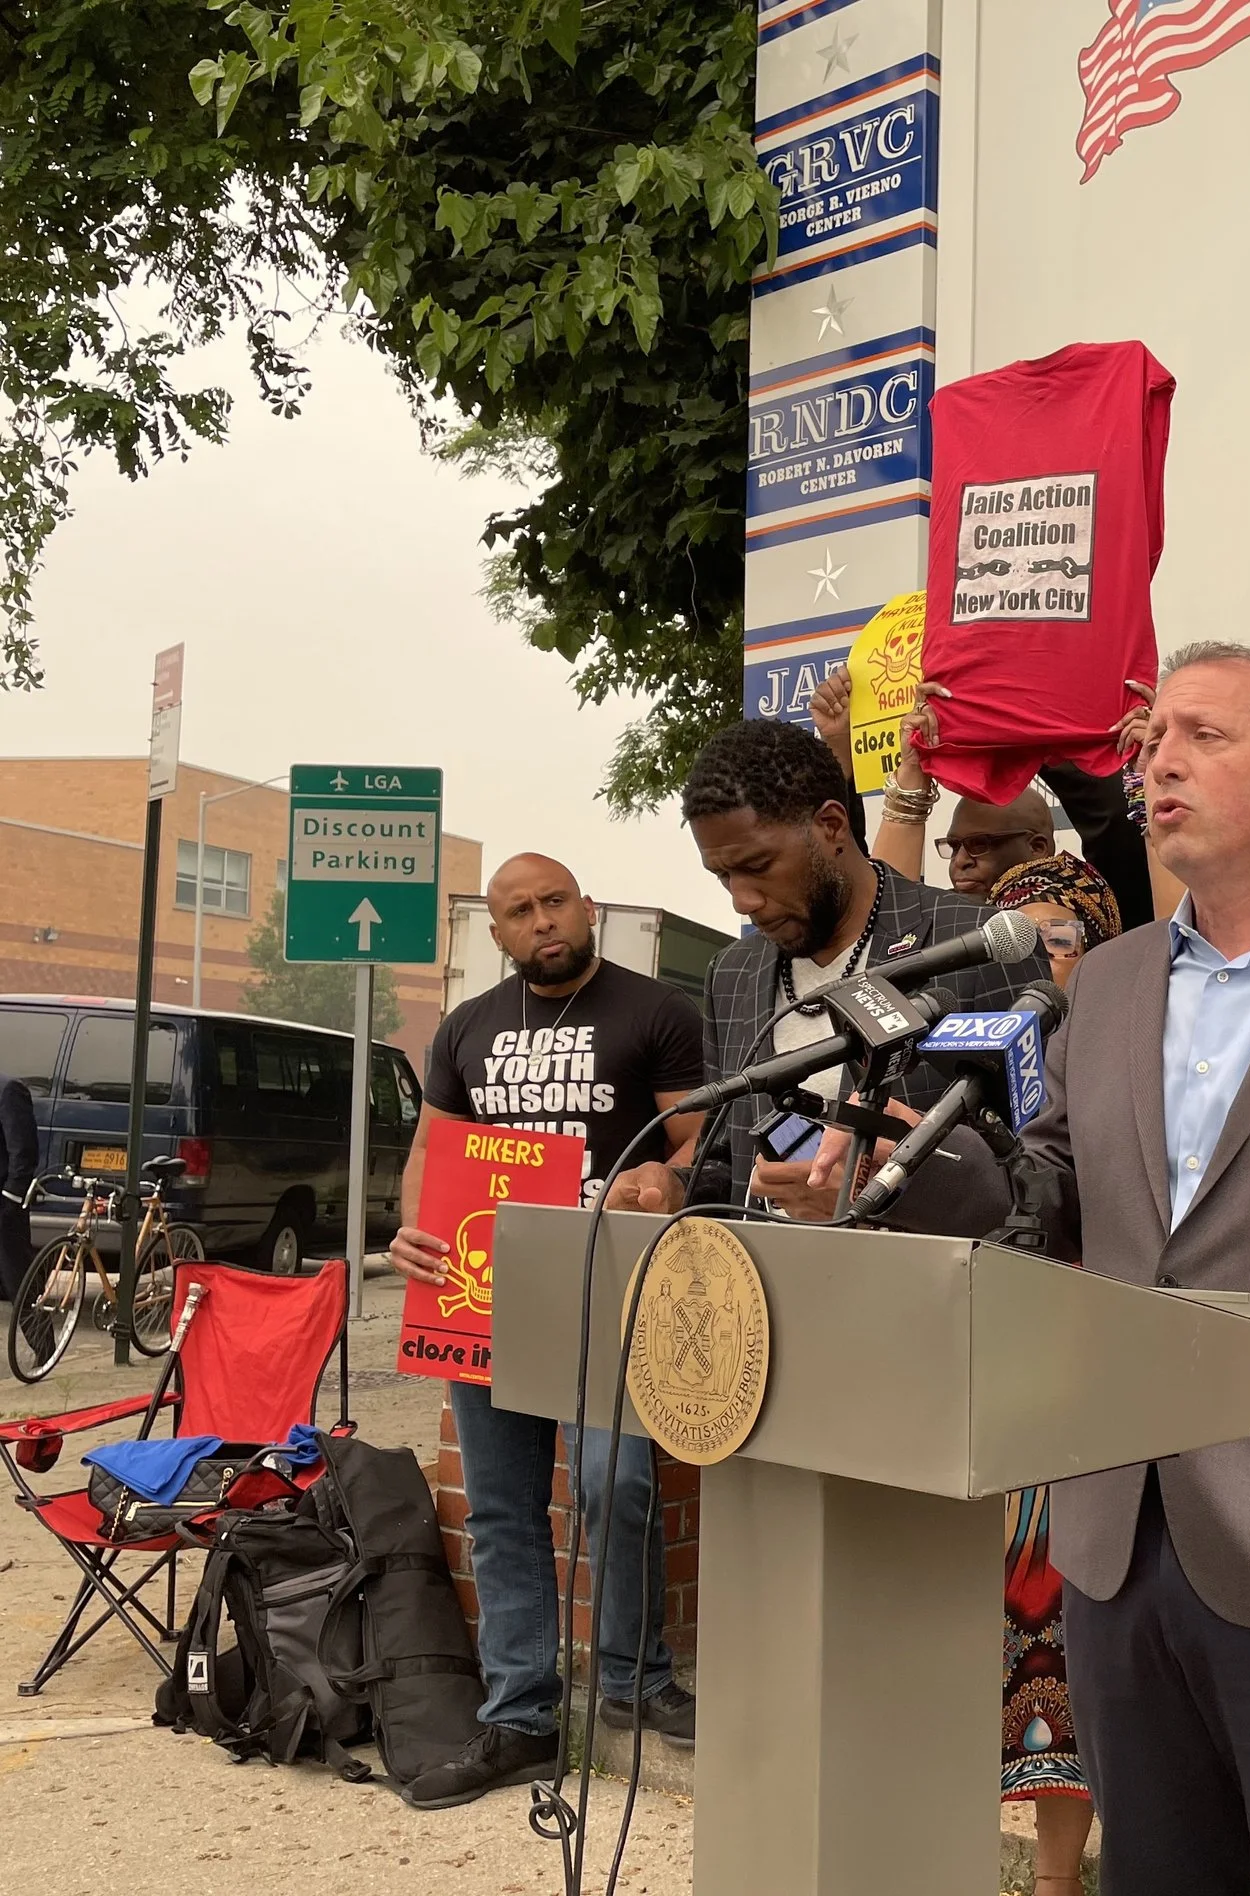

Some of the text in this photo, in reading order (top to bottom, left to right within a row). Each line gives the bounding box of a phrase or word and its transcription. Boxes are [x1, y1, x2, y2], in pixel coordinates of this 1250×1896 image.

[764, 104, 915, 198] GRVC
[780, 173, 902, 229] EORGE R. VIERNO
[806, 206, 862, 237] CENTER
[748, 370, 918, 461] RNDC
[758, 438, 904, 487] ROBERT N. DAVOREN
[800, 469, 857, 495] CENTER
[964, 484, 1091, 516] Jails Action
[974, 521, 1076, 550] Coalition
[955, 588, 1085, 614] New York City
[854, 728, 894, 754] close
[364, 774, 403, 791] LGA
[303, 817, 426, 839] Discount
[311, 850, 417, 875] Parking
[851, 990, 885, 1017] NEWS
[858, 980, 896, 1012] SPECTRUM
[491, 1026, 594, 1056] CLOSE
[484, 1053, 594, 1084] YOUTH
[470, 1083, 615, 1115] PRISONS
[465, 1133, 546, 1167] RIKERS
[489, 1173, 511, 1199] IS
[402, 1335, 466, 1365] close
[638, 1319, 756, 1440] SIGILLUM CIVITATIS NOVI EBORACI
[680, 1402, 707, 1417] 1625
